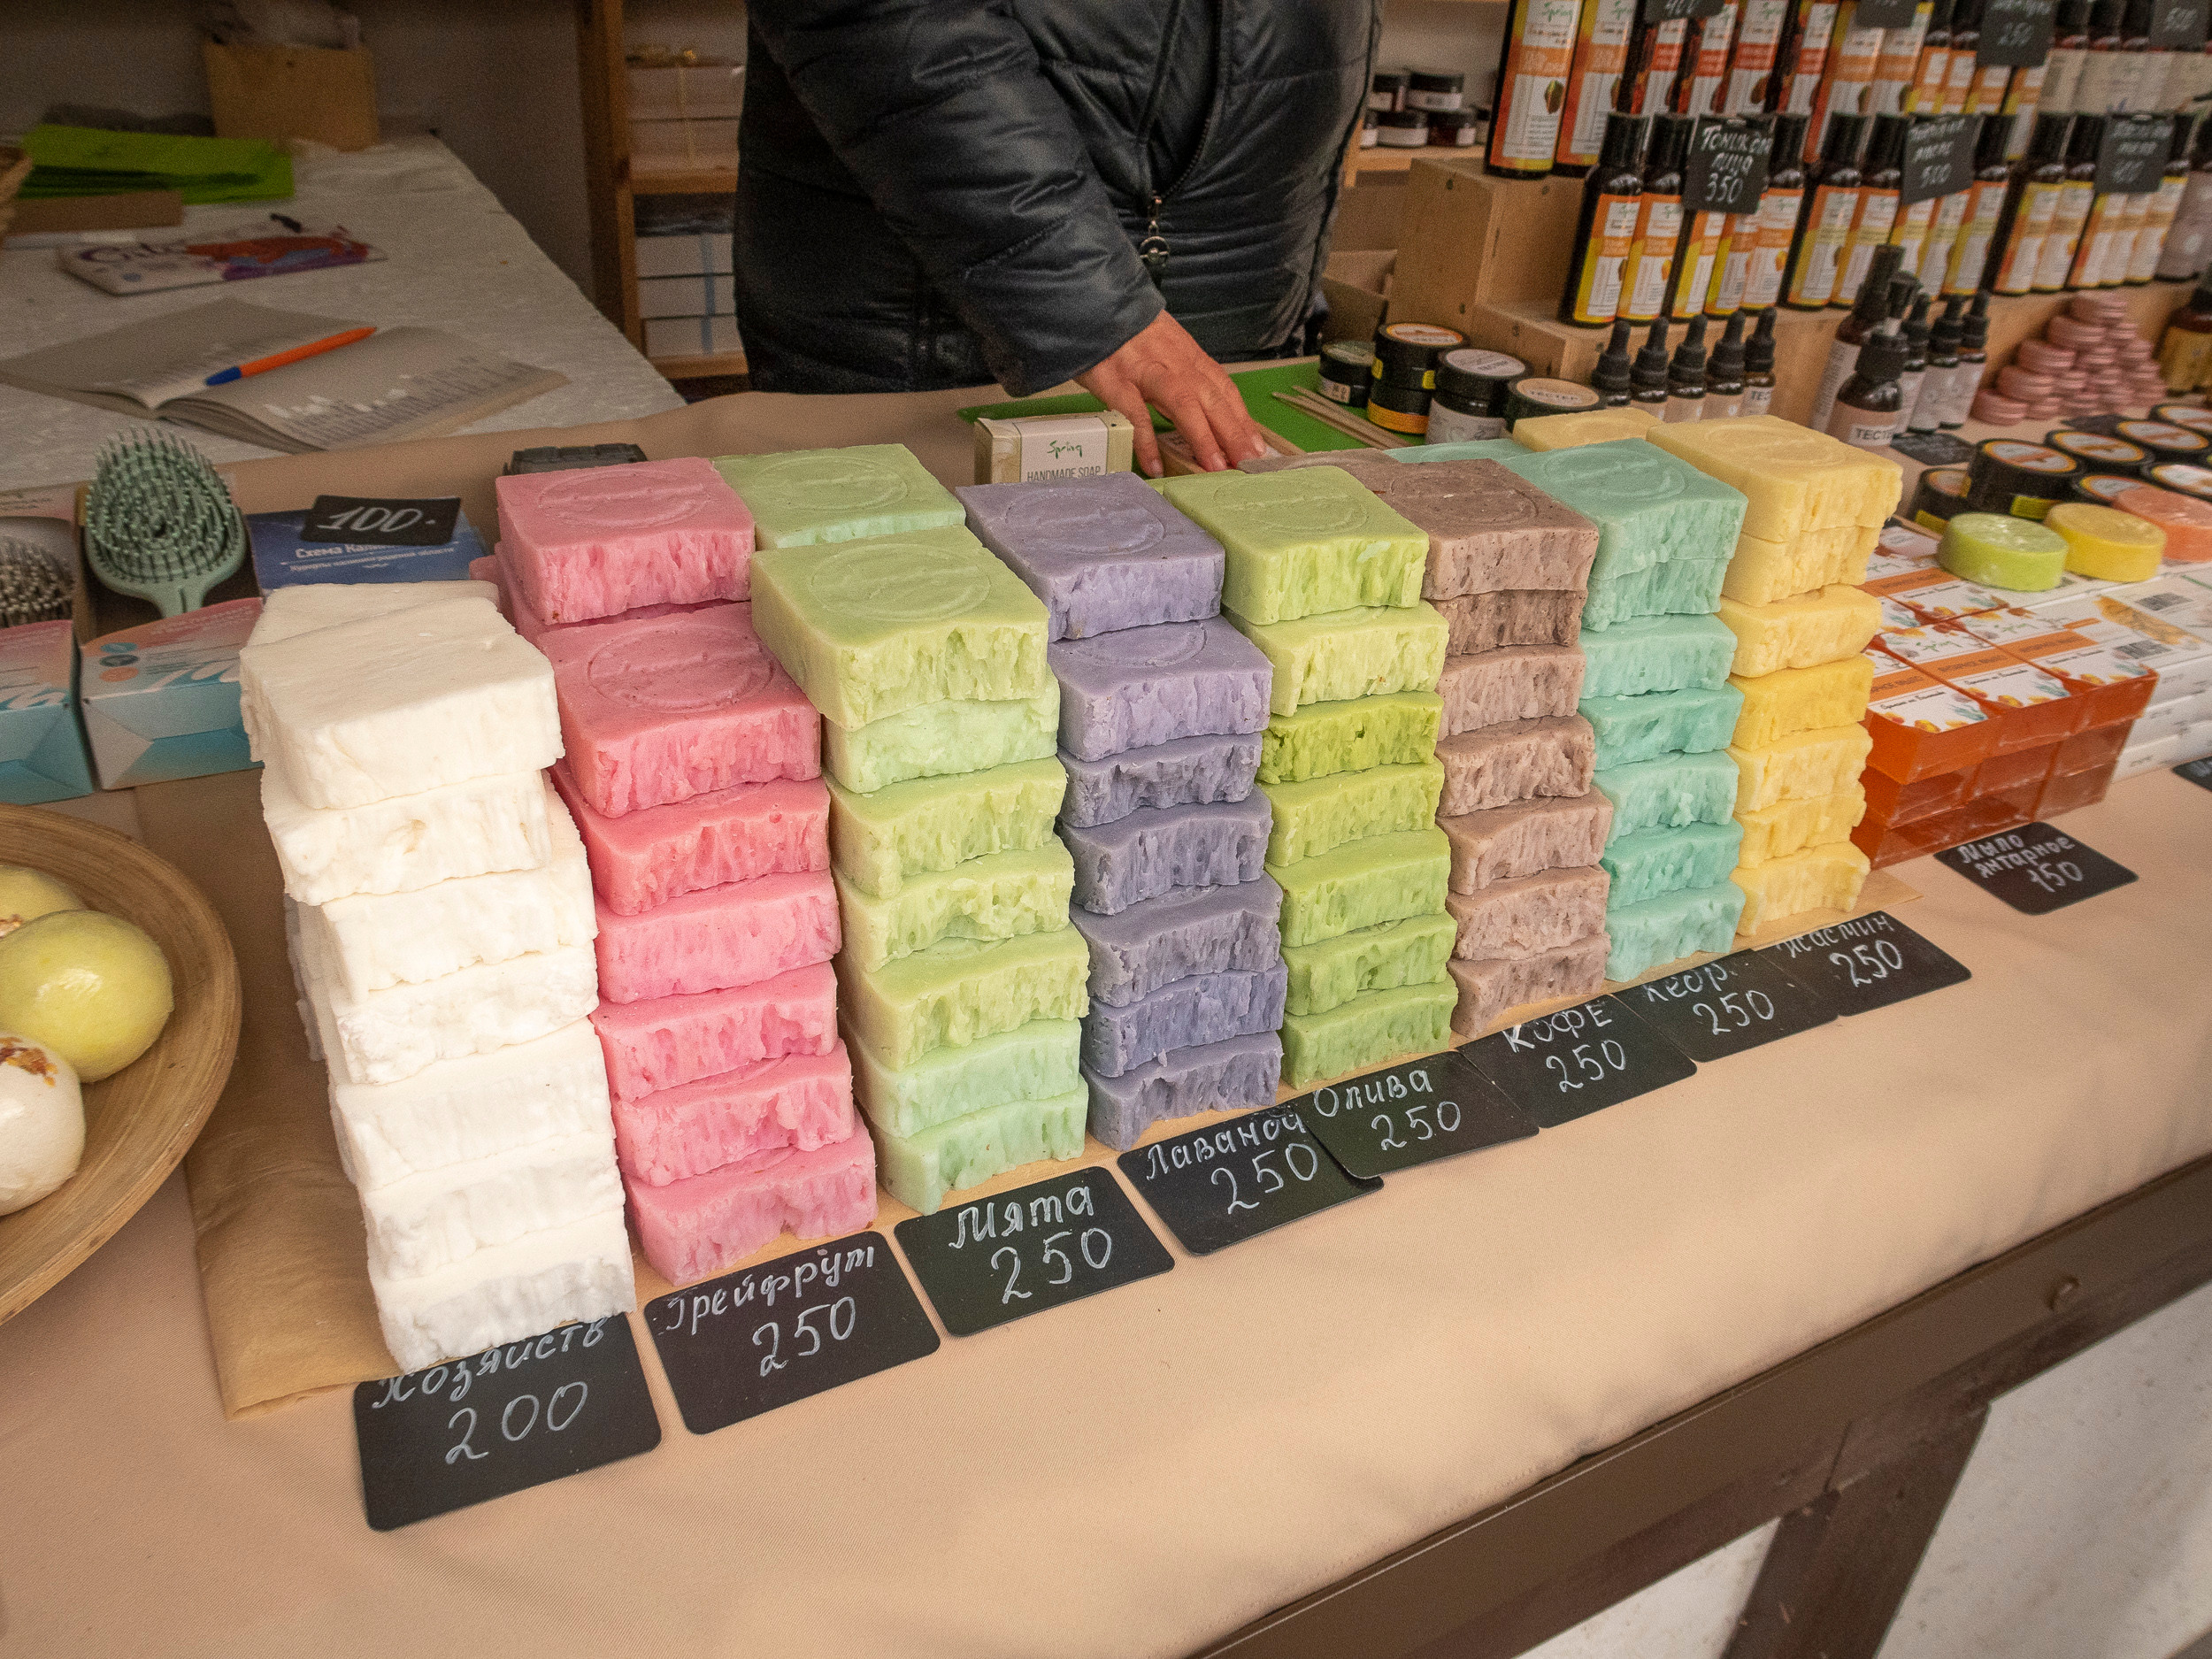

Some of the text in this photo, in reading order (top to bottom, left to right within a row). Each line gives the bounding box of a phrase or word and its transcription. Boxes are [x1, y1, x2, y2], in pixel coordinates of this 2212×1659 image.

[1701, 125, 1749, 151] Тоник
[1705, 173, 1744, 204] 350
[1027, 465, 1101, 483] HANDMADE SOAP
[1957, 834, 2024, 864] Мыло
[2027, 861, 2083, 893] 150
[1829, 940, 1902, 987] 250
[1693, 989, 1775, 1035] 250
[1546, 1040, 1626, 1093] 250
[1371, 1102, 1462, 1150] 250
[1210, 1143, 1318, 1215] 250
[948, 1181, 1094, 1250] Мята
[990, 1227, 1112, 1304] 250
[753, 1296, 857, 1377] 250
[445, 1381, 588, 1464] 200
